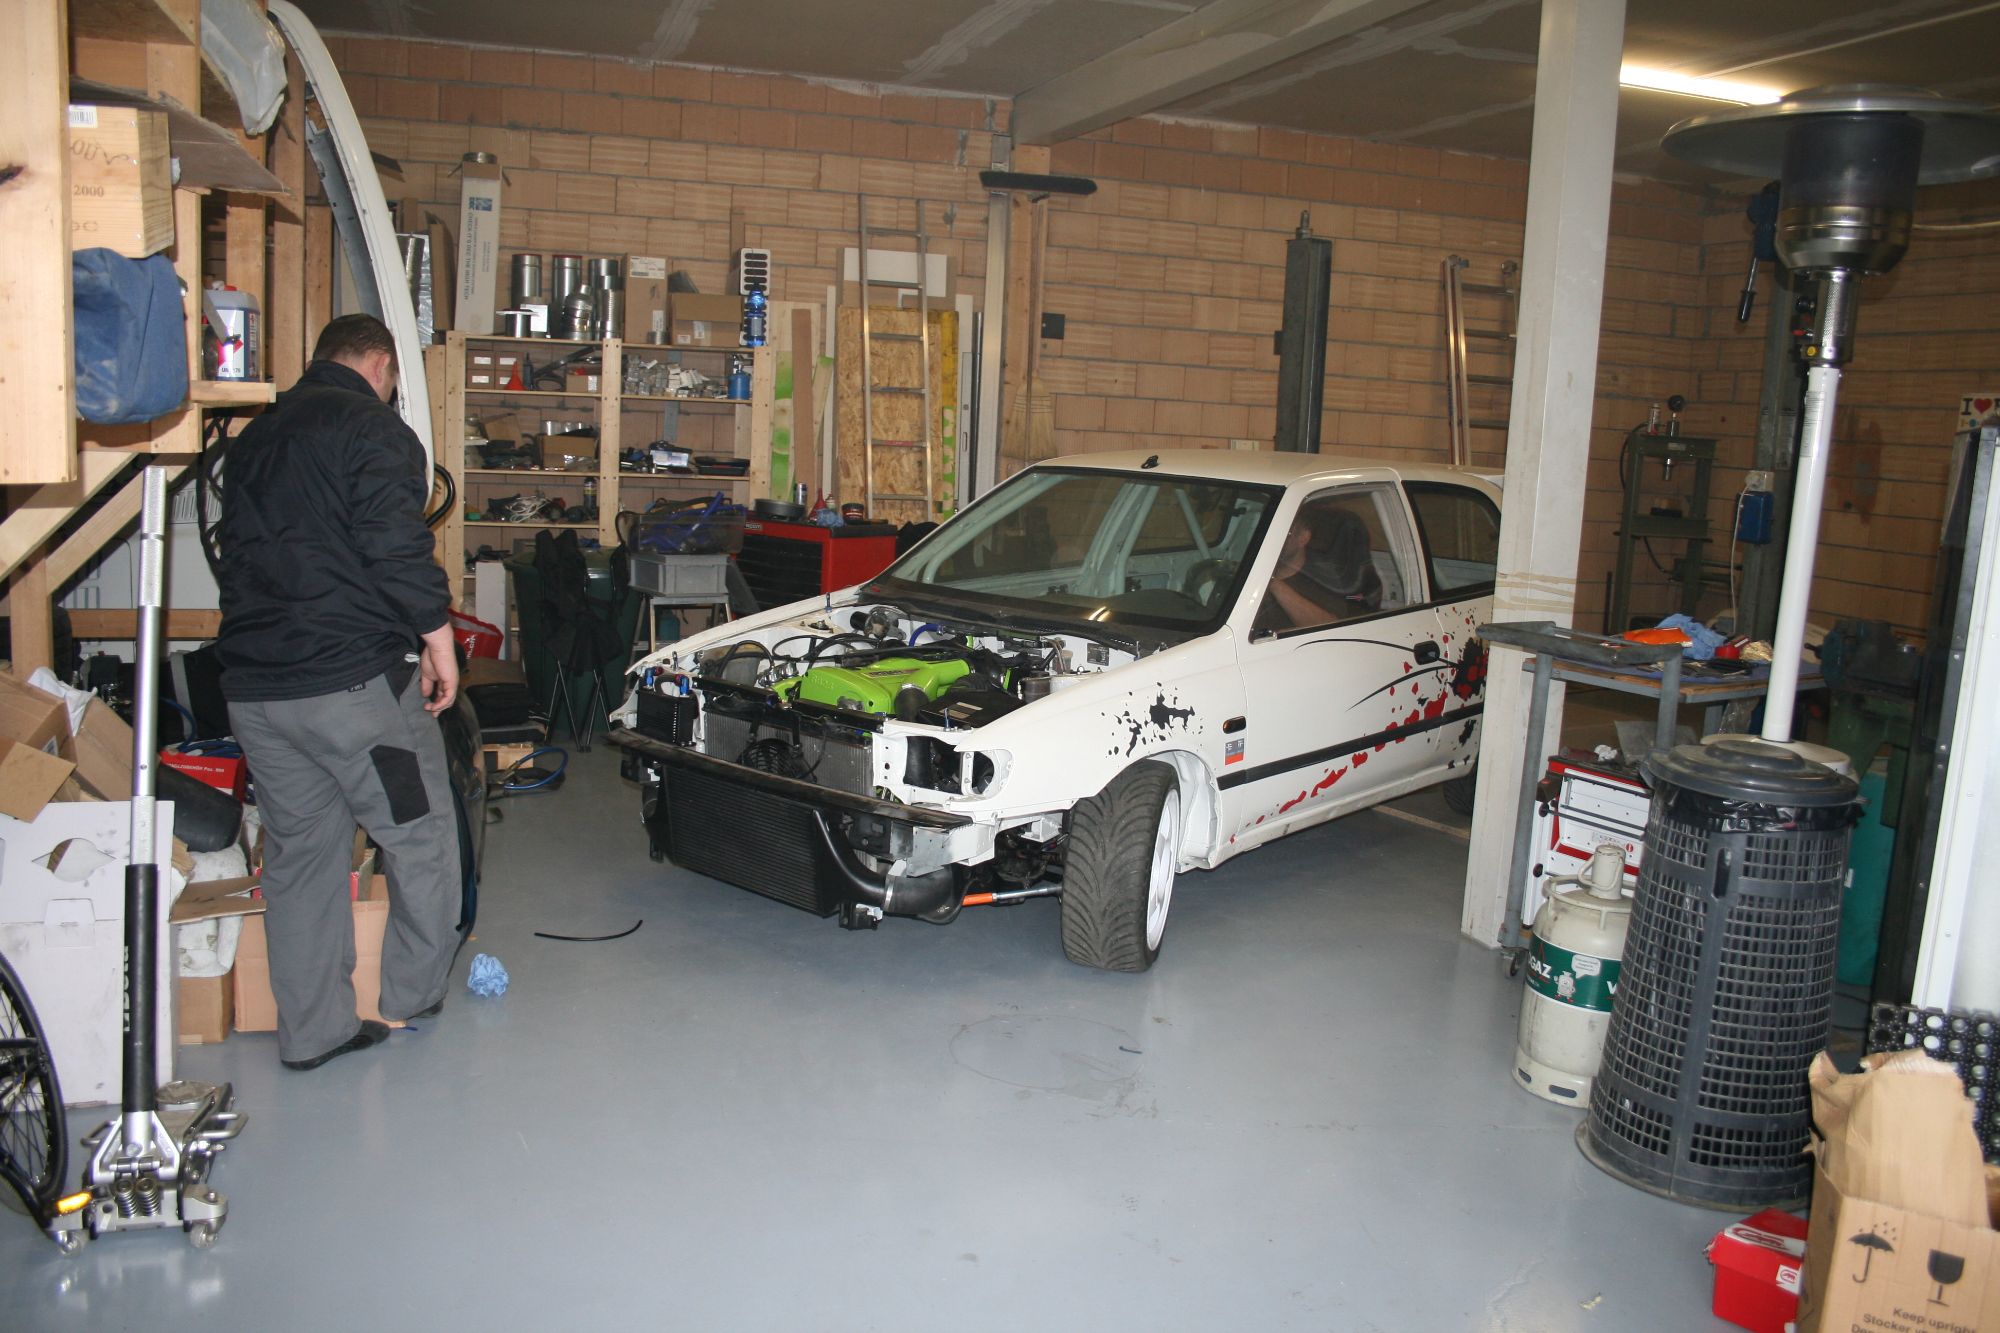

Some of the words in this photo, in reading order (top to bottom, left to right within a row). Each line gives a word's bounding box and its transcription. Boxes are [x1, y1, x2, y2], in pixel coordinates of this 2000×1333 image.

[73, 184, 105, 198] 2000
[1862, 1312, 1911, 1333] Stocker
[1893, 1307, 1926, 1325] Keep
